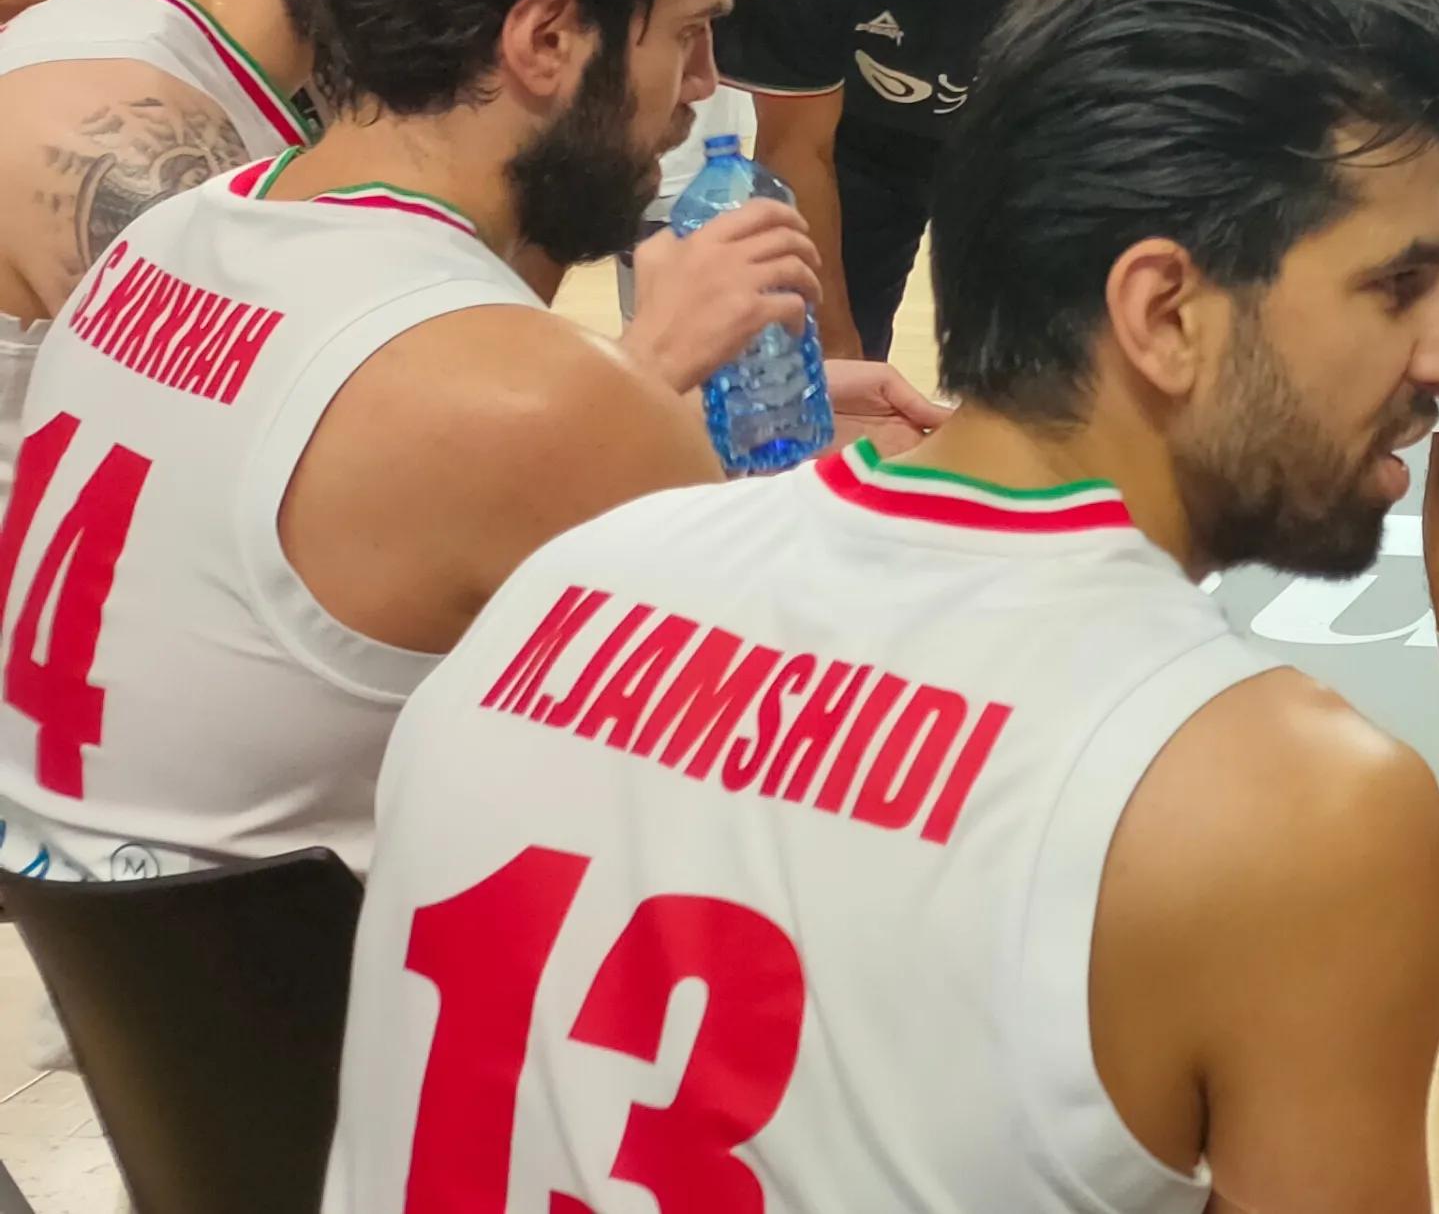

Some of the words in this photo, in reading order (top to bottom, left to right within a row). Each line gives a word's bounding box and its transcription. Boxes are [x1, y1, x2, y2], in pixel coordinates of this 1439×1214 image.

[0, 410, 154, 800] 14
[479, 584, 1012, 846] M.JAMSHIDI
[403, 843, 806, 1214] 13
